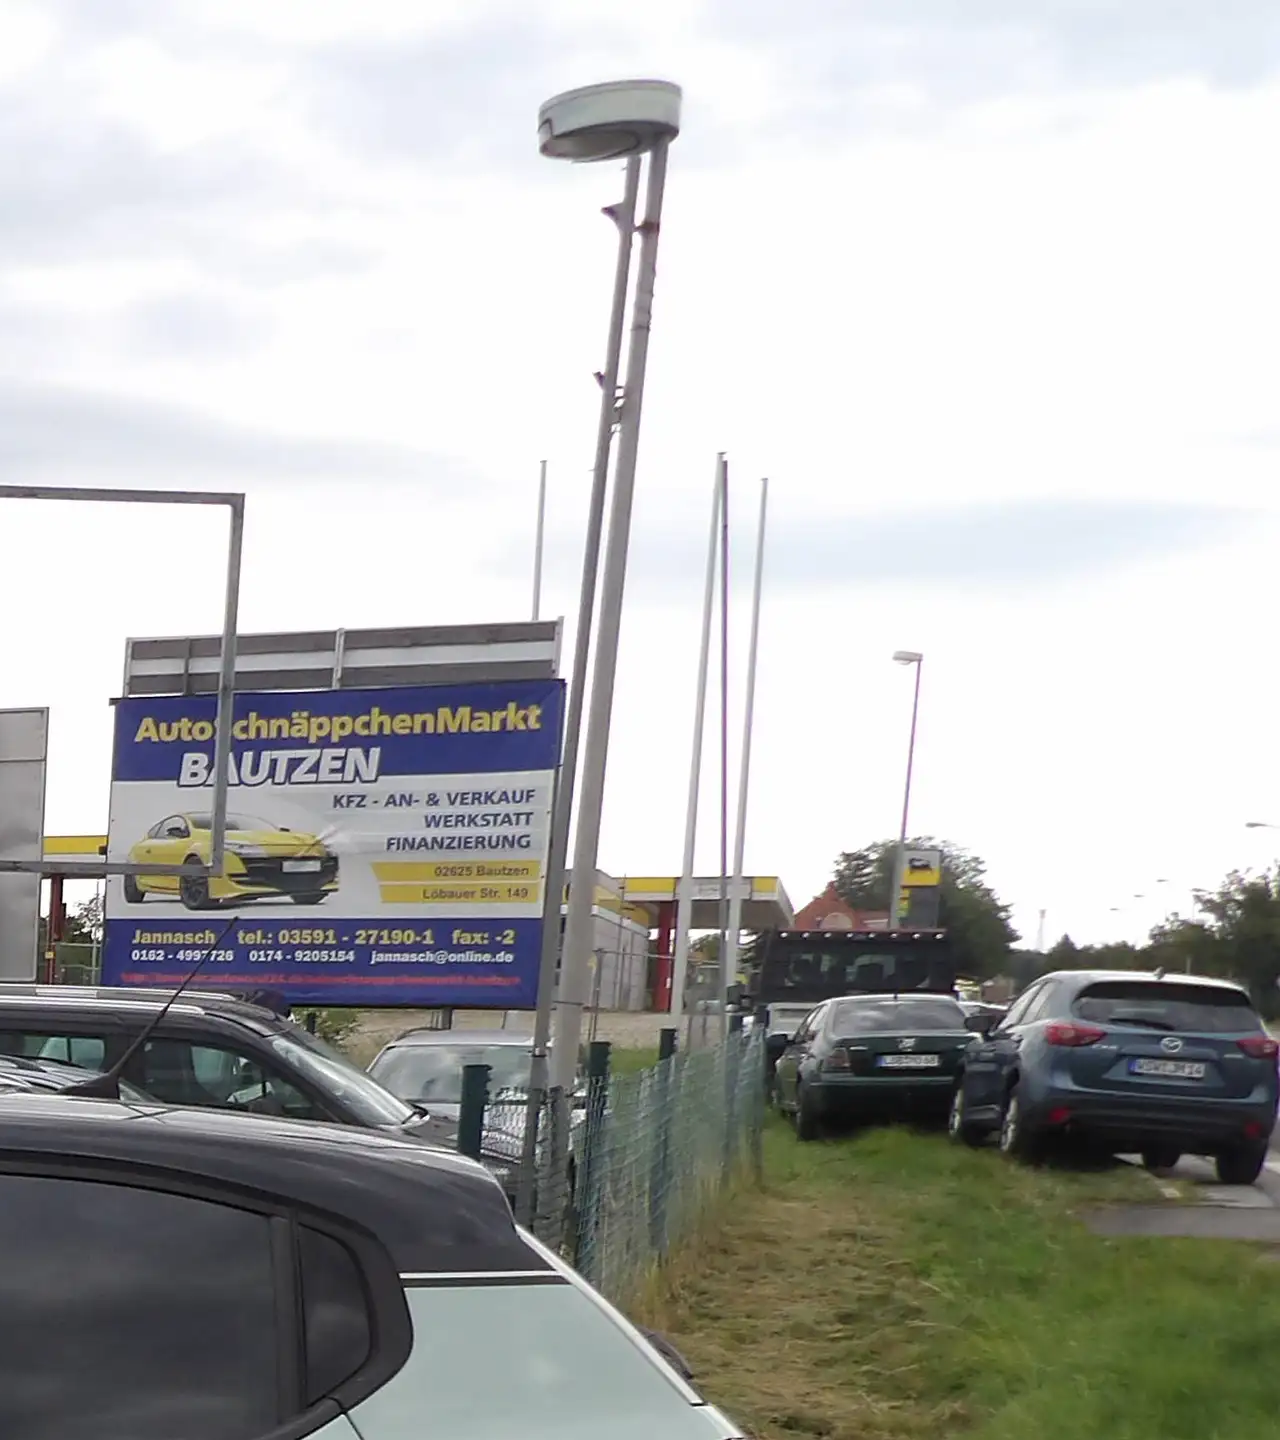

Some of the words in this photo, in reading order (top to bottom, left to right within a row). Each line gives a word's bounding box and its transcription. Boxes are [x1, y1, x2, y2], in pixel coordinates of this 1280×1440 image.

[134, 702, 542, 743] AutochnäppchenMarkt
[178, 747, 381, 787] BAUTZEN
[333, 794, 367, 809] KFZ
[384, 793, 420, 808] AN-
[425, 792, 440, 807] &
[447, 789, 536, 806] VERKAUF
[424, 812, 534, 829] WERKSTATT
[386, 835, 531, 852] FINANZIERUNG
[434, 865, 473, 877] 02625
[476, 864, 529, 876] Bautzen
[480, 887, 501, 899] Str.
[507, 887, 529, 899] 149
[132, 930, 216, 945] Jannasch
[237, 930, 273, 945] tel.:
[278, 929, 337, 945] 03591
[354, 929, 435, 945] 27190-1
[452, 929, 489, 945] fax:
[495, 930, 516, 945] -2
[131, 950, 165, 961] 0162
[249, 950, 283, 962] 0174
[294, 950, 355, 962] 9205154
[370, 950, 514, 965] jannasch@online.de
